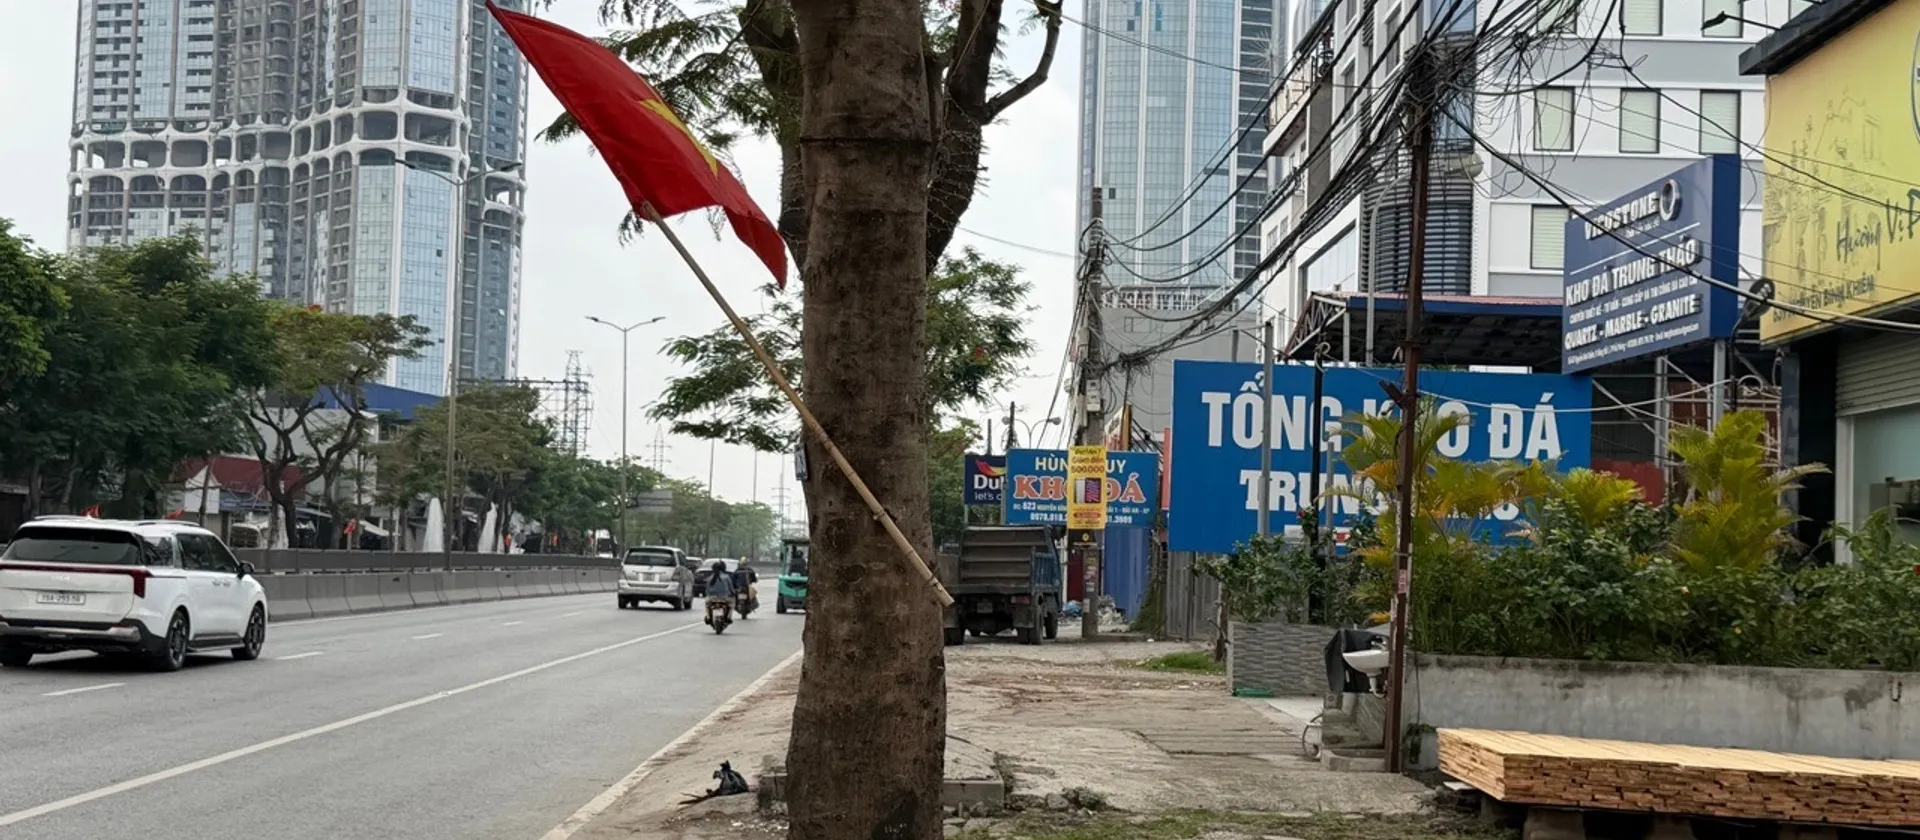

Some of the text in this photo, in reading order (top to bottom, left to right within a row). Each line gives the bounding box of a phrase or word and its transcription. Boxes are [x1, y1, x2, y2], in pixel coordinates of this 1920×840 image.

[1585, 191, 1657, 240] VICOSTONE
[1566, 279, 1589, 307] KHO
[1592, 265, 1609, 297] ĐÁ
[1612, 255, 1655, 290] TRUNG
[1564, 324, 1598, 350] QUARTZ
[1604, 311, 1642, 338] MARBLE
[1650, 294, 1696, 325] GRANITE
[1201, 371, 1343, 452] TỔNG
[1488, 392, 1562, 460] ĐÁ
[973, 474, 1005, 490] Dul
[1013, 475, 1068, 500] KH
[1035, 453, 1126, 473] HÙN UY
